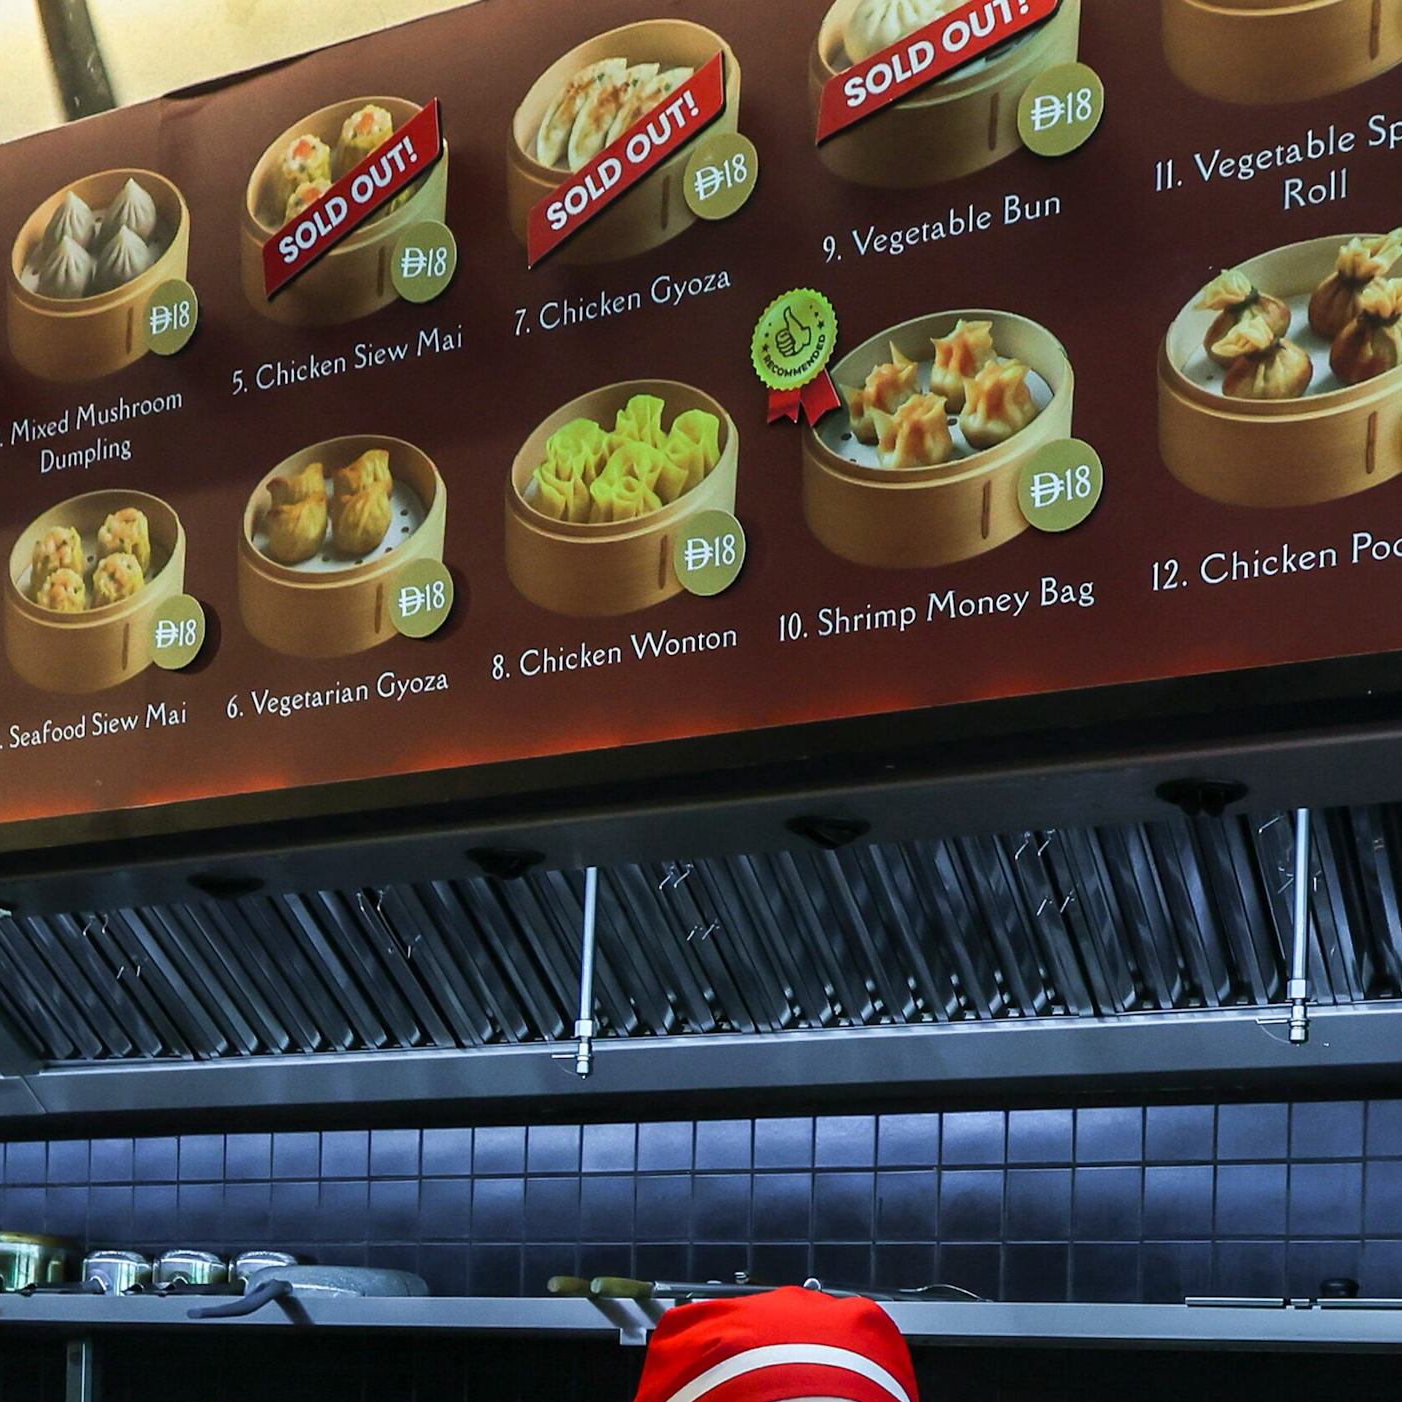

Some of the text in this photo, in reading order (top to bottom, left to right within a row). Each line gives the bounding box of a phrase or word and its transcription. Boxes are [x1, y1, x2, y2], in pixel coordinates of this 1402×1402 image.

[844, 40, 935, 107] SOLD
[546, 90, 700, 231] SOLD OUT!
[1155, 159, 1183, 192] 11.
[1194, 125, 1356, 182] Vegetable
[278, 136, 418, 264] SOLD OUT!
[1284, 167, 1347, 210] Roll
[822, 194, 1061, 263] 9. Vegetable Bun
[514, 270, 731, 335] 7. Chicken Gyoza
[232, 325, 463, 395] 5. Chicken Siew Mai
[763, 334, 826, 377] RECOMMENDED
[10, 406, 68, 445] Mixed
[76, 392, 182, 431] Mushroom
[40, 437, 132, 473] Dumpling
[1151, 559, 1188, 591] 12.
[1200, 543, 1337, 585] Chicken
[779, 576, 1095, 642] 10. Shrimp Money Bag
[491, 629, 737, 680] 8. Chicken Wonton
[226, 671, 449, 719] 6. Vegetarian Gyoza
[9, 715, 86, 749] Seafood
[91, 710, 138, 737] Siew
[145, 701, 187, 728] Mai
